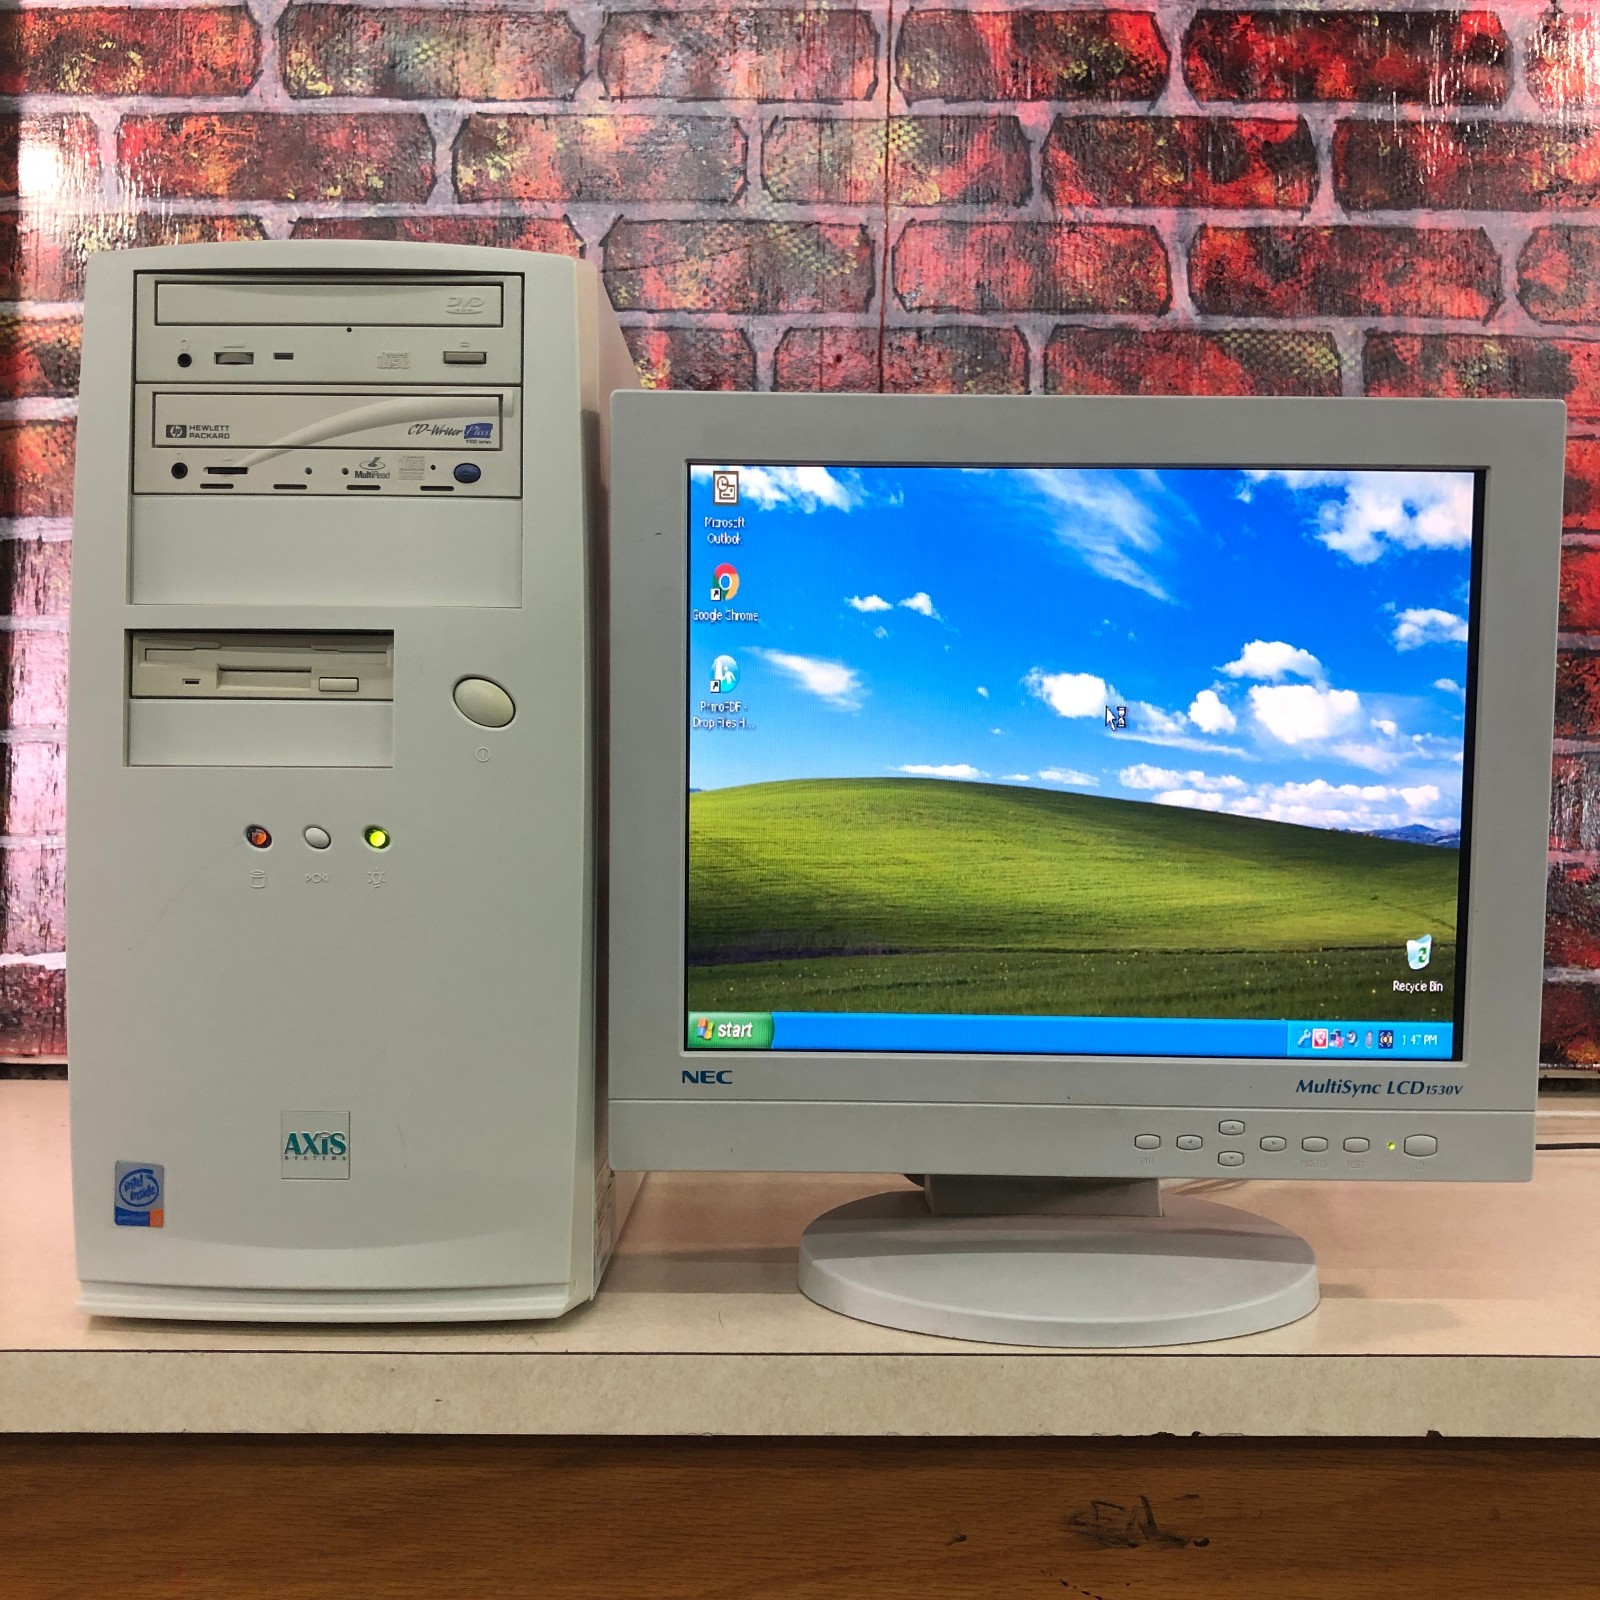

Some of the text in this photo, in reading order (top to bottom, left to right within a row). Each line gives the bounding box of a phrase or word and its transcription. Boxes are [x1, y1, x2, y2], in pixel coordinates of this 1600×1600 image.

[446, 297, 485, 308] DVD
[189, 424, 230, 432] HEWLETT
[407, 423, 489, 437] CD-Writer Plus
[189, 432, 230, 440] PACKARD
[354, 470, 391, 480] MultiRead
[693, 608, 759, 623] Google Chrome
[692, 716, 715, 730] Drop
[1392, 980, 1444, 993] Recycle Bin
[717, 1021, 753, 1038] start
[1402, 1034, 1438, 1046] 147 PM
[682, 1070, 733, 1084] NEC
[1296, 1078, 1382, 1098] MultiSync
